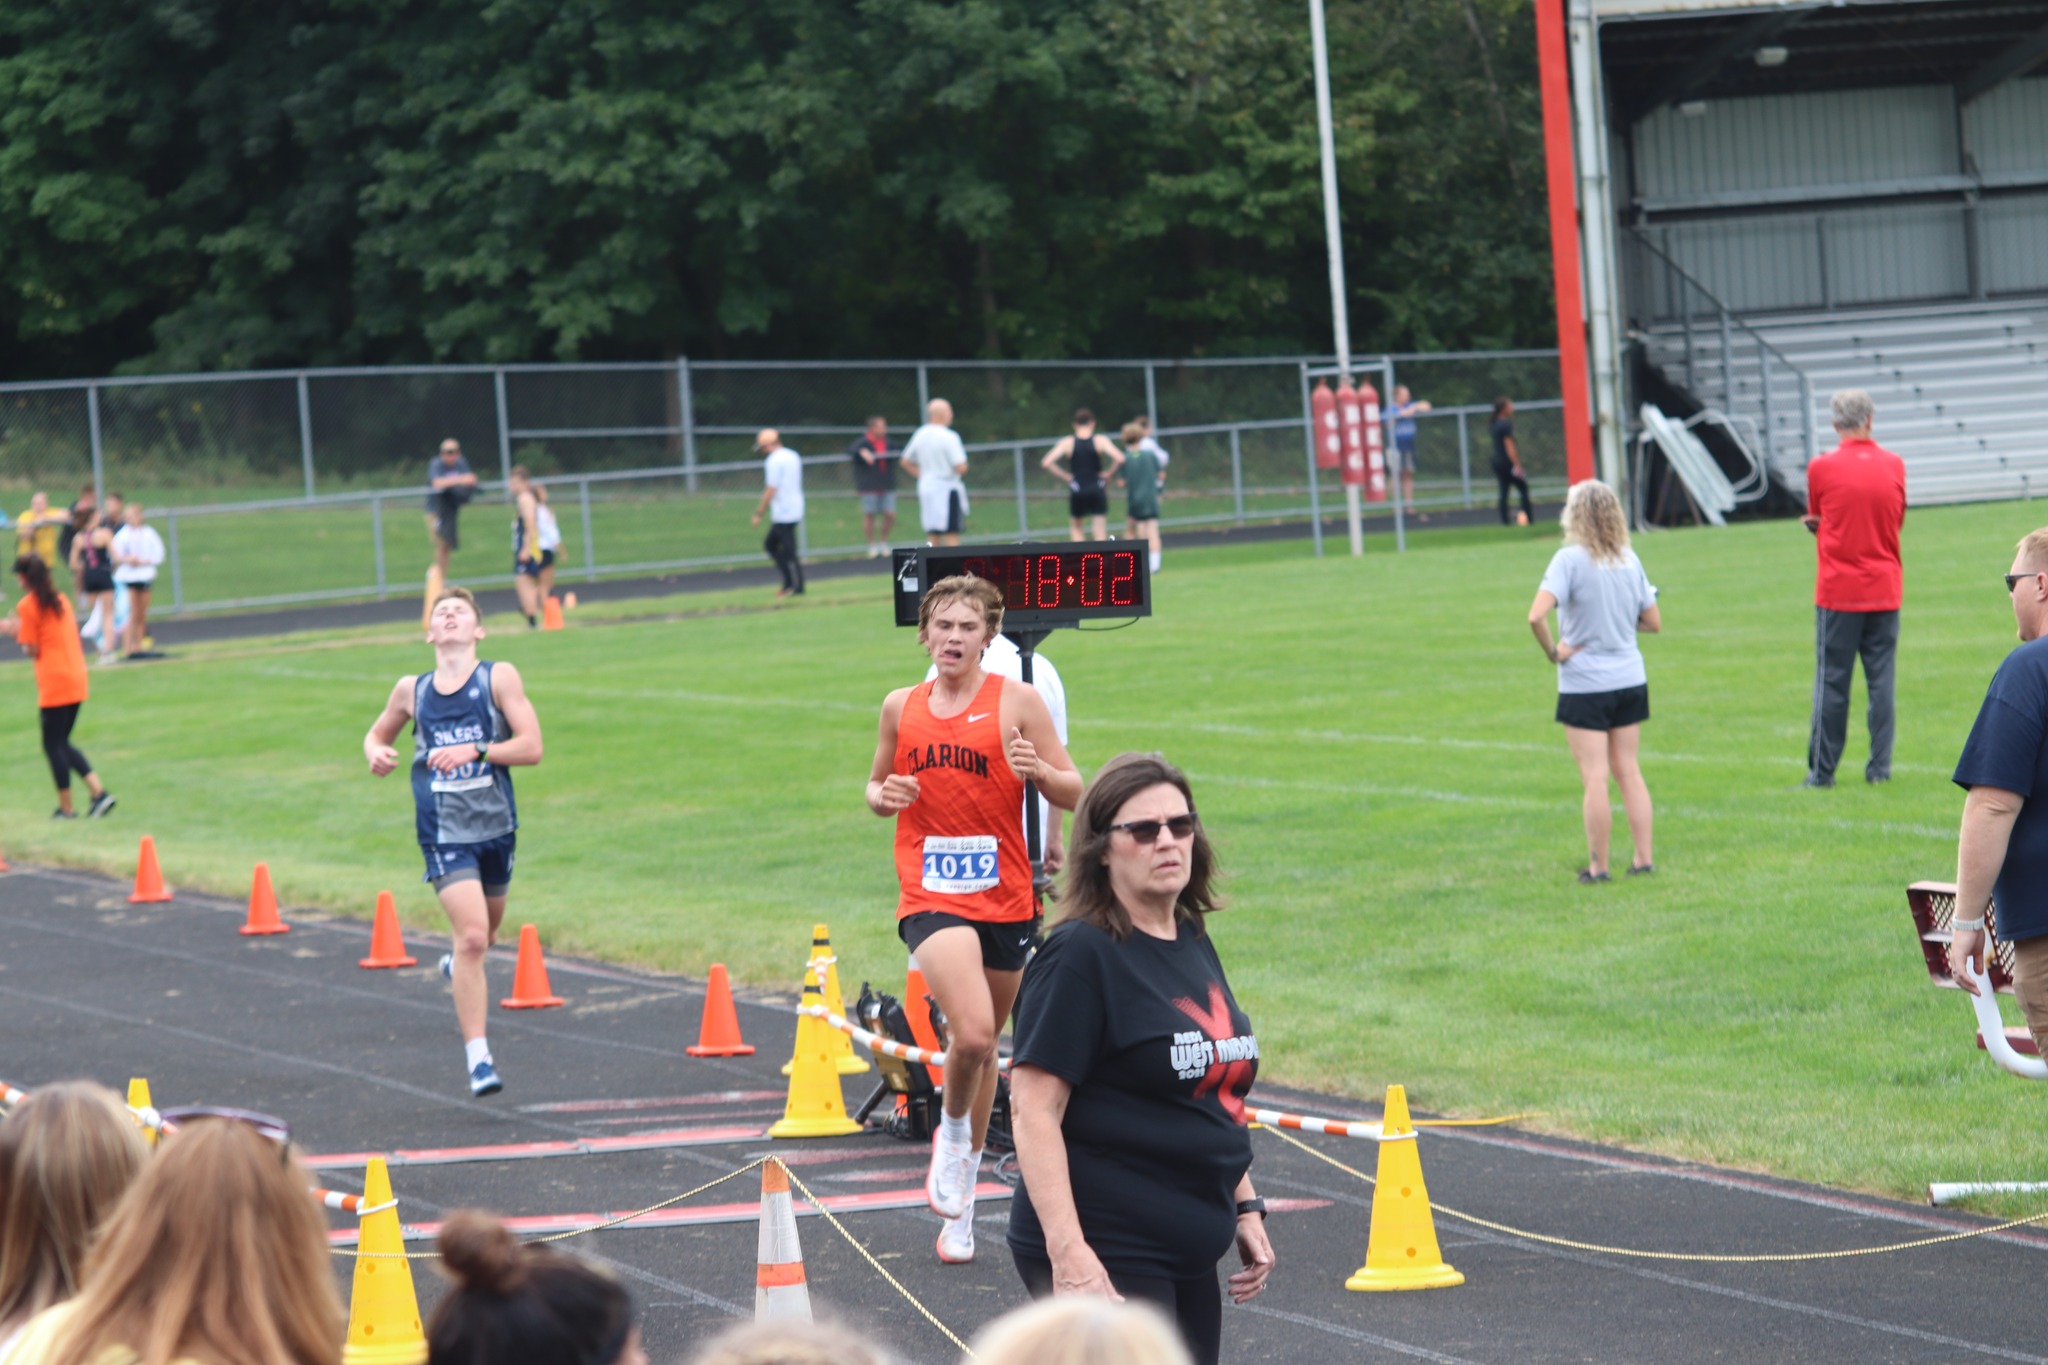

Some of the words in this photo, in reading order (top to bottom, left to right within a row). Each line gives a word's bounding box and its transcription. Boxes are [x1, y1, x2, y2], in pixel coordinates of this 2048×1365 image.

[1025, 552, 1134, 608] 18:02
[908, 744, 988, 779] CLARION
[925, 853, 996, 879] 1019
[1170, 1041, 1215, 1071] WEST
